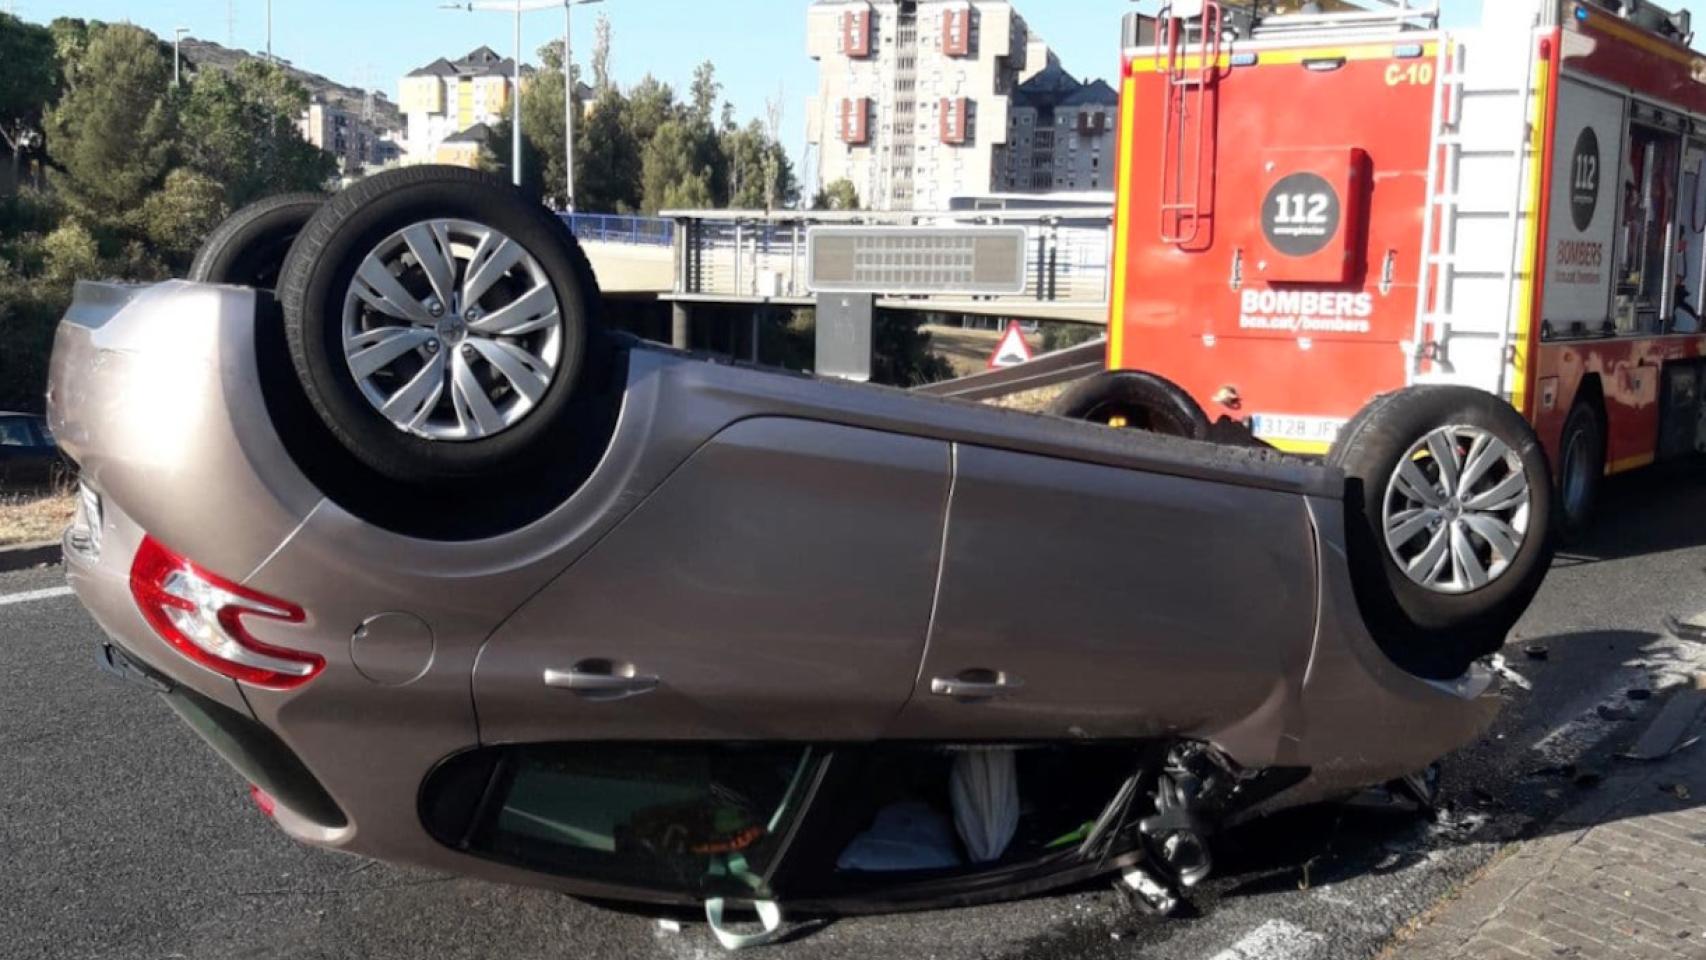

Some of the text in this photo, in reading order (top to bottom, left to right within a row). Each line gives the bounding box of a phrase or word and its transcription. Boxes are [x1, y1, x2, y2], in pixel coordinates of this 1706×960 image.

[1385, 63, 1432, 86] C-10
[1575, 154, 1596, 190] 112
[1274, 193, 1328, 223] 112
[1241, 289, 1372, 316] BOMBERS
[1264, 418, 1306, 435] 3128
